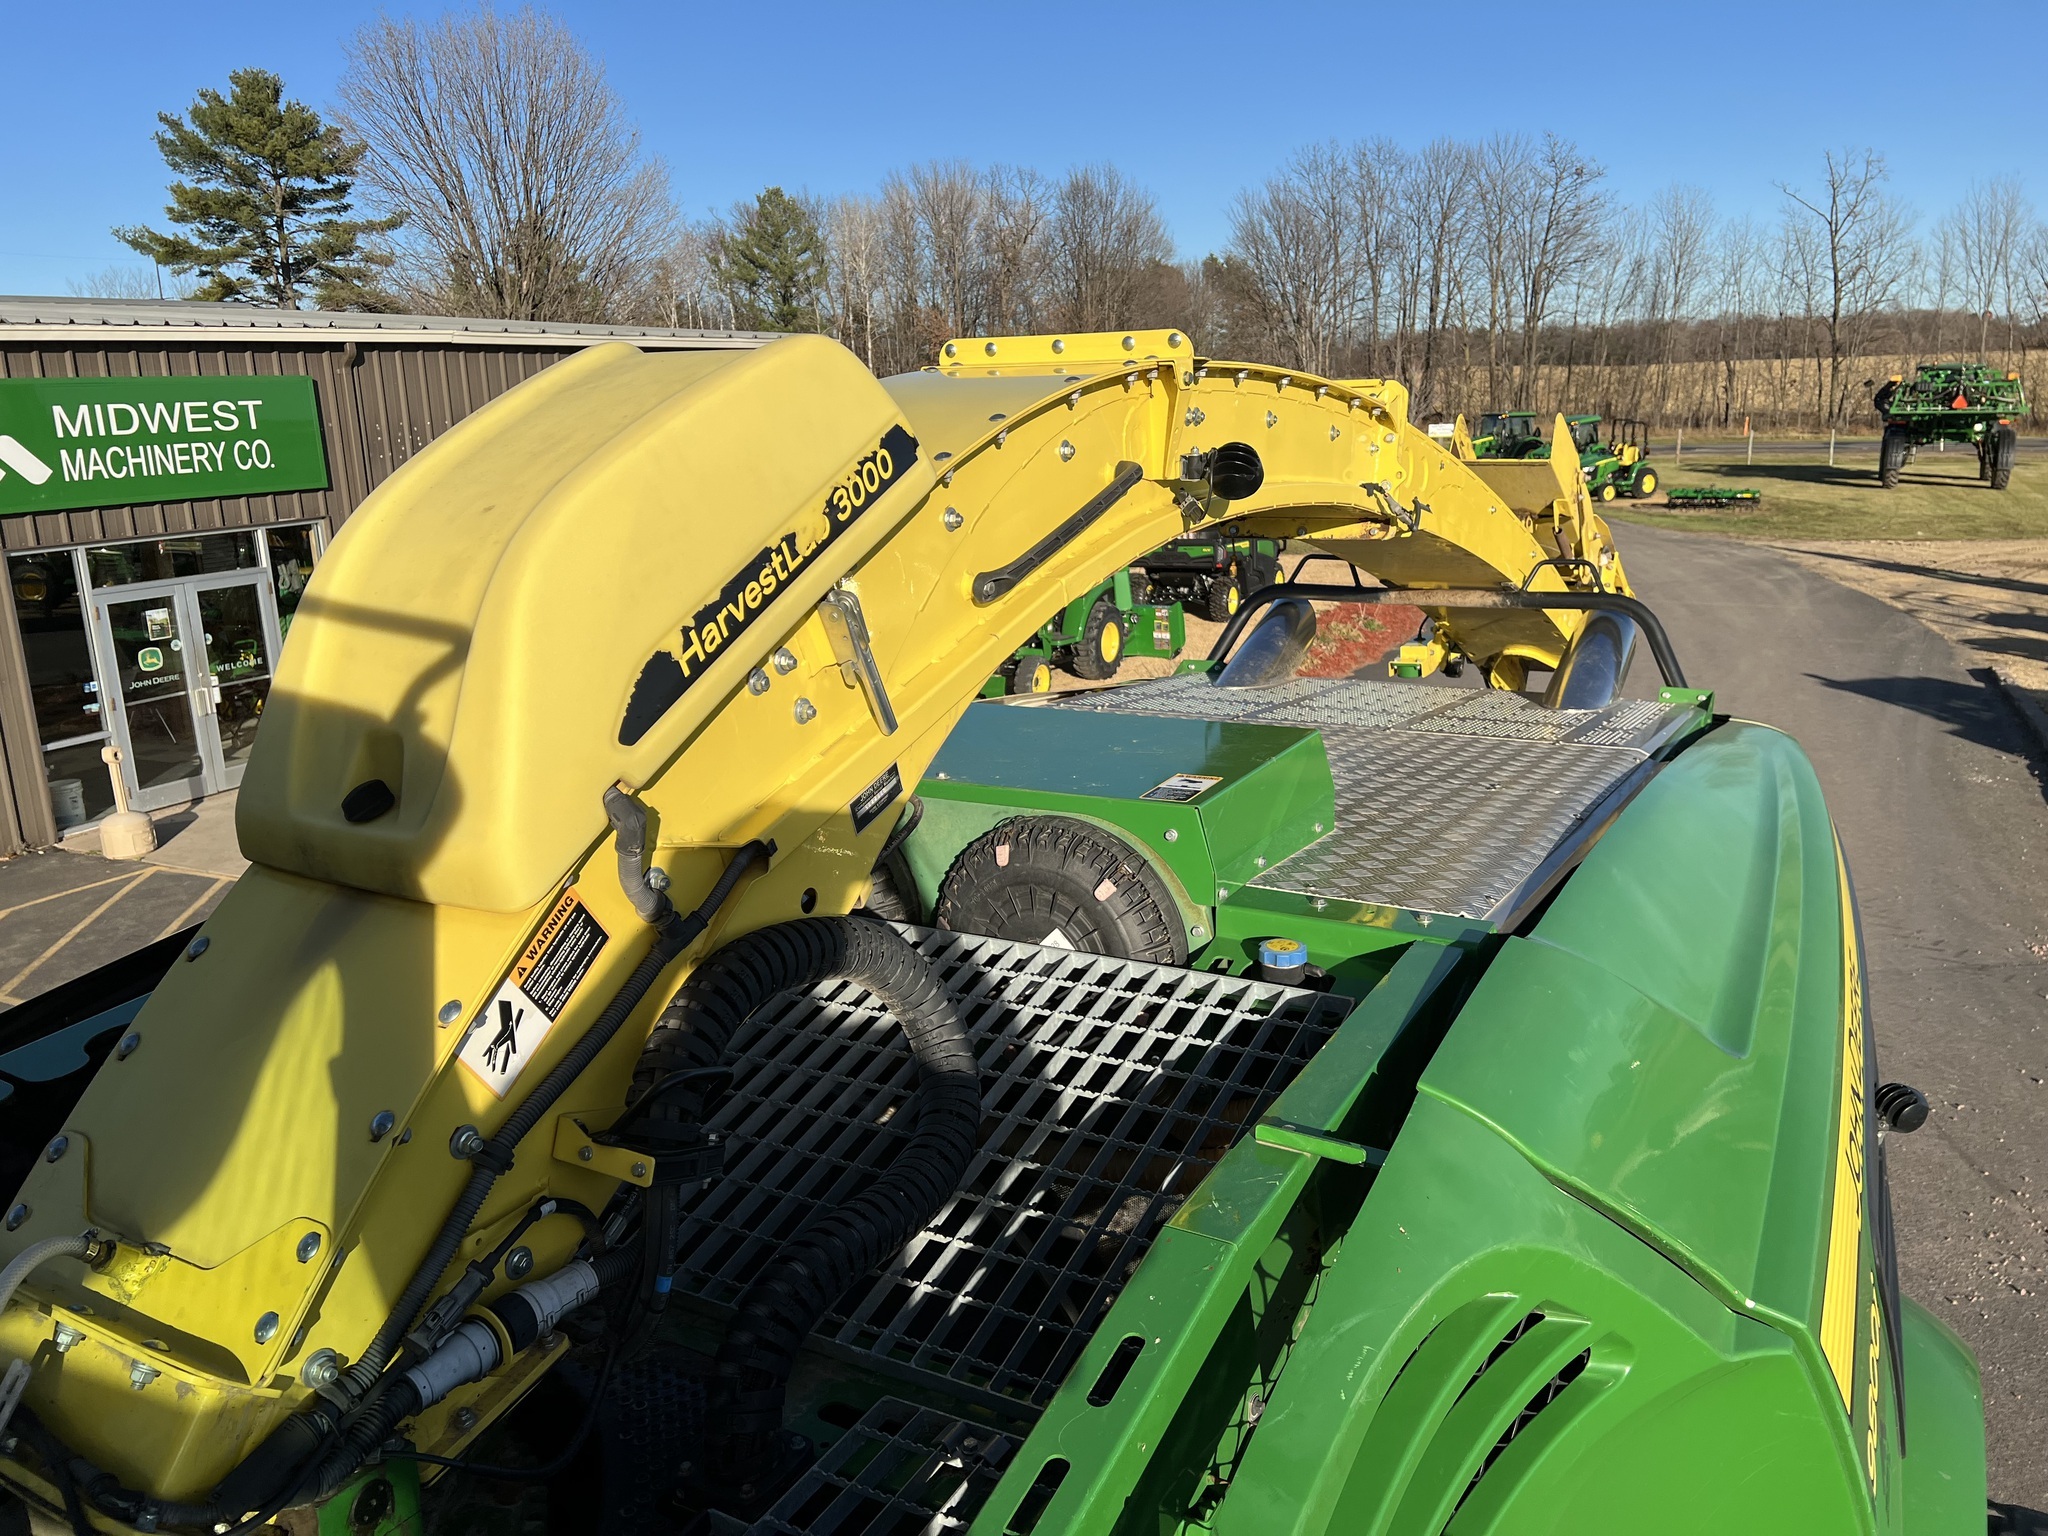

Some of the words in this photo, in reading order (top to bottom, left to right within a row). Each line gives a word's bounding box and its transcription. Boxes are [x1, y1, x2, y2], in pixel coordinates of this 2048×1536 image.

[52, 399, 263, 438] MIDWEST
[59, 441, 226, 482] MACHINERY
[233, 438, 276, 471] CO.
[831, 448, 894, 523] 3000
[129, 680, 152, 690] JOHN
[152, 673, 180, 685] DEERE
[525, 895, 574, 962] WARNING
[1845, 1083, 1862, 1220] JOHN
[1867, 1270, 1881, 1498] 9800i
